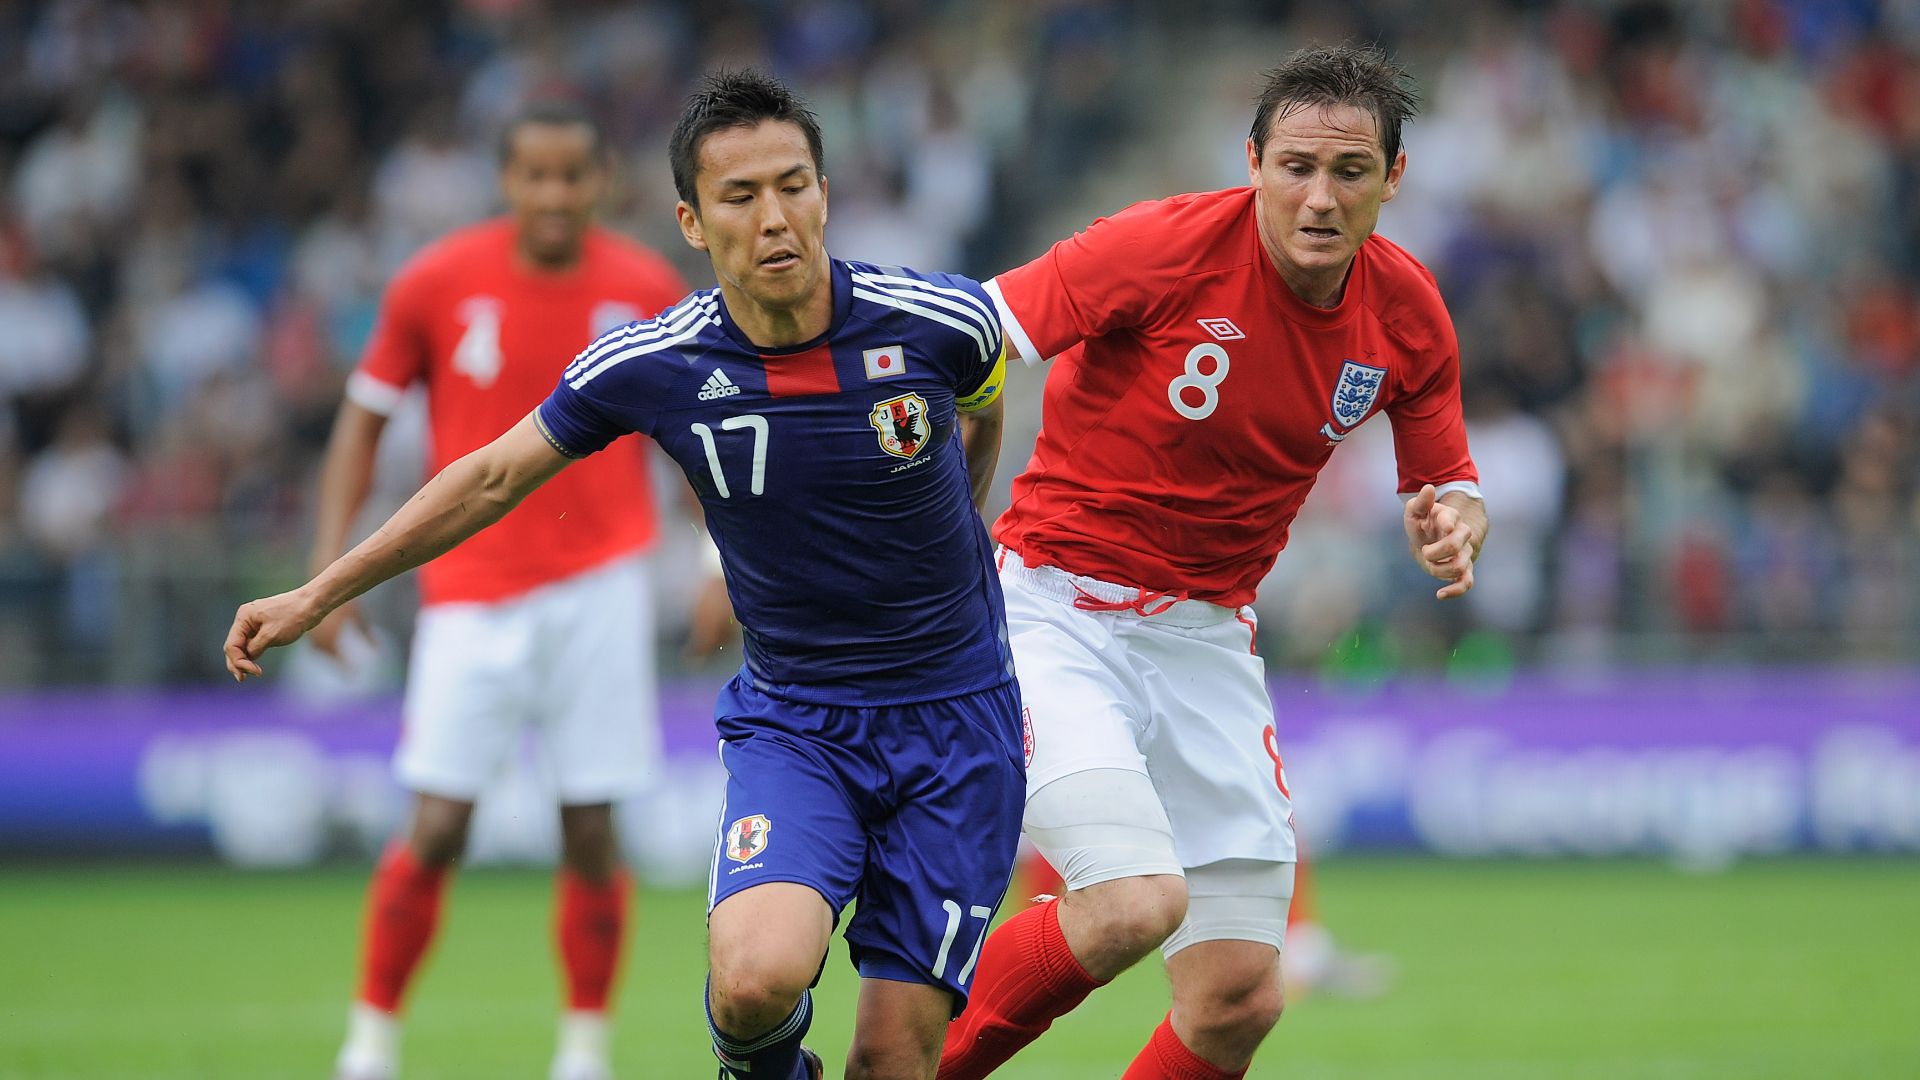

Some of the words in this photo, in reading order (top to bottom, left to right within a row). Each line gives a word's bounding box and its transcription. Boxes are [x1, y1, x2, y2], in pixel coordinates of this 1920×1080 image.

[451, 294, 506, 389] 4
[697, 385, 741, 401] adidas
[1167, 342, 1230, 420] 8
[880, 401, 918, 420] JFA
[690, 414, 769, 499] 17
[890, 455, 931, 473] JAPAN
[728, 862, 764, 875] JAPAN
[931, 899, 992, 986] 17
